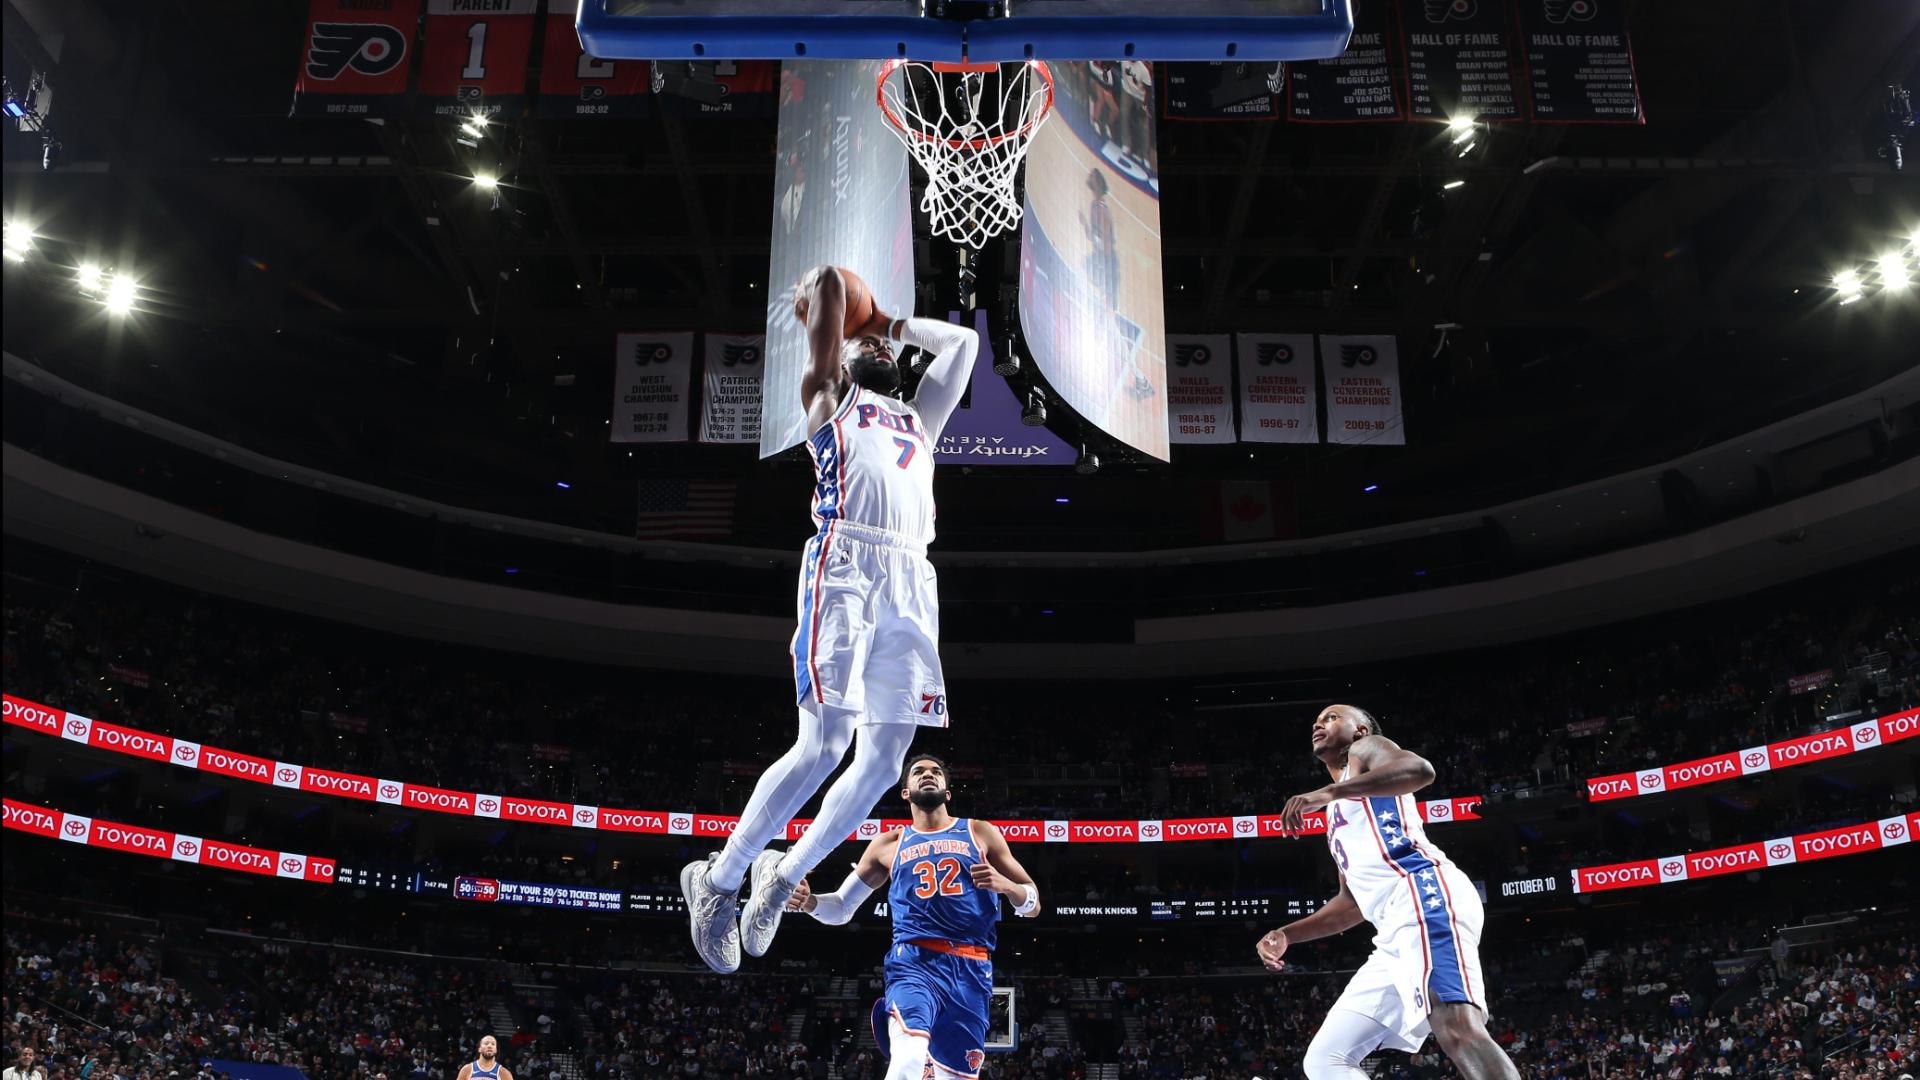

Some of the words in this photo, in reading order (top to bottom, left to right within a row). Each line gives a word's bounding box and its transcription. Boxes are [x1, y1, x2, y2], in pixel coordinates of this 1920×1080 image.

[452, 0, 512, 11] PARENT
[1352, 33, 1382, 46] AME
[1411, 33, 1444, 46] HALL
[1445, 33, 1462, 46] OF
[1463, 33, 1501, 46] FAME
[1532, 33, 1566, 46] HALL
[1566, 34, 1583, 46] OF
[1584, 35, 1621, 47] FAME
[462, 22, 487, 79] 1
[639, 375, 665, 385] WEST
[720, 376, 760, 386] PATRICK
[1256, 375, 1298, 385] EASTERN
[1340, 377, 1382, 386] EASTERN
[631, 385, 672, 394] DIVISION
[719, 386, 760, 395] DIVISION
[1167, 386, 1225, 395] CONFERENCE
[1248, 385, 1307, 395] CONFERENCE
[1333, 386, 1392, 396] CONFERENCE
[624, 394, 679, 404] CHAMPIONS
[1168, 395, 1224, 405] CHAMPIONS
[1249, 395, 1306, 404] CHAMPIONS
[1335, 396, 1391, 405] CHAMPIONS
[857, 403, 922, 438] PHIL
[1178, 414, 1216, 423] 1984-85
[1259, 418, 1300, 429] 1996-97
[1179, 425, 1216, 434] 1986-87
[1344, 419, 1386, 430] 2009-10
[943, 436, 1004, 445] AREN
[893, 436, 917, 470] 7
[969, 445, 1049, 458] xfinity
[921, 694, 945, 714] 76
[1588, 779, 1632, 798] YOTA
[1669, 758, 1736, 784] TOYOTA
[1774, 735, 1848, 762] TOYOTA
[1884, 714, 1919, 736] TOY
[3, 700, 58, 729] OYOTA
[96, 727, 166, 756] TOYOTA
[205, 751, 269, 778] TOYOTA
[307, 772, 371, 795] TOYOTA
[408, 789, 470, 810] TOYOTA
[507, 802, 568, 820] TOYOTA
[603, 812, 663, 829] TOYOTA
[698, 819, 738, 832] TOYO
[994, 825, 1039, 837] YOTA
[1073, 825, 1133, 838] TOYOTA
[1168, 821, 1229, 837] TOYOTA
[1263, 816, 1325, 832] TOTA
[3, 806, 55, 831] OYOTA
[97, 826, 167, 852] TOYOTA
[207, 846, 272, 870] TOYOTA
[900, 842, 930, 864] NEW
[932, 839, 972, 858] YORK
[1585, 866, 1654, 886] TOYOTA
[1691, 849, 1760, 872] TOYOTA
[1799, 829, 1876, 855] TOYOTA
[340, 867, 353, 875] PHI
[338, 875, 353, 884] NYK
[912, 856, 964, 900] 32
[437, 882, 448, 890] PM
[460, 883, 471, 893] 50
[483, 886, 495, 895] 50
[1502, 879, 1544, 897] OCTOBER
[1545, 876, 1556, 892] 10
[501, 883, 519, 893] BUY
[519, 884, 542, 896] YOUR
[543, 887, 568, 899] 50/50
[569, 889, 597, 901] TICKETS
[598, 892, 621, 903] NOW!
[542, 897, 554, 905] $25
[606, 902, 621, 910] $100
[874, 903, 888, 917] 41
[1056, 907, 1078, 915] NEW
[1079, 907, 1103, 915] YORK
[1105, 907, 1138, 915] KNICKS
